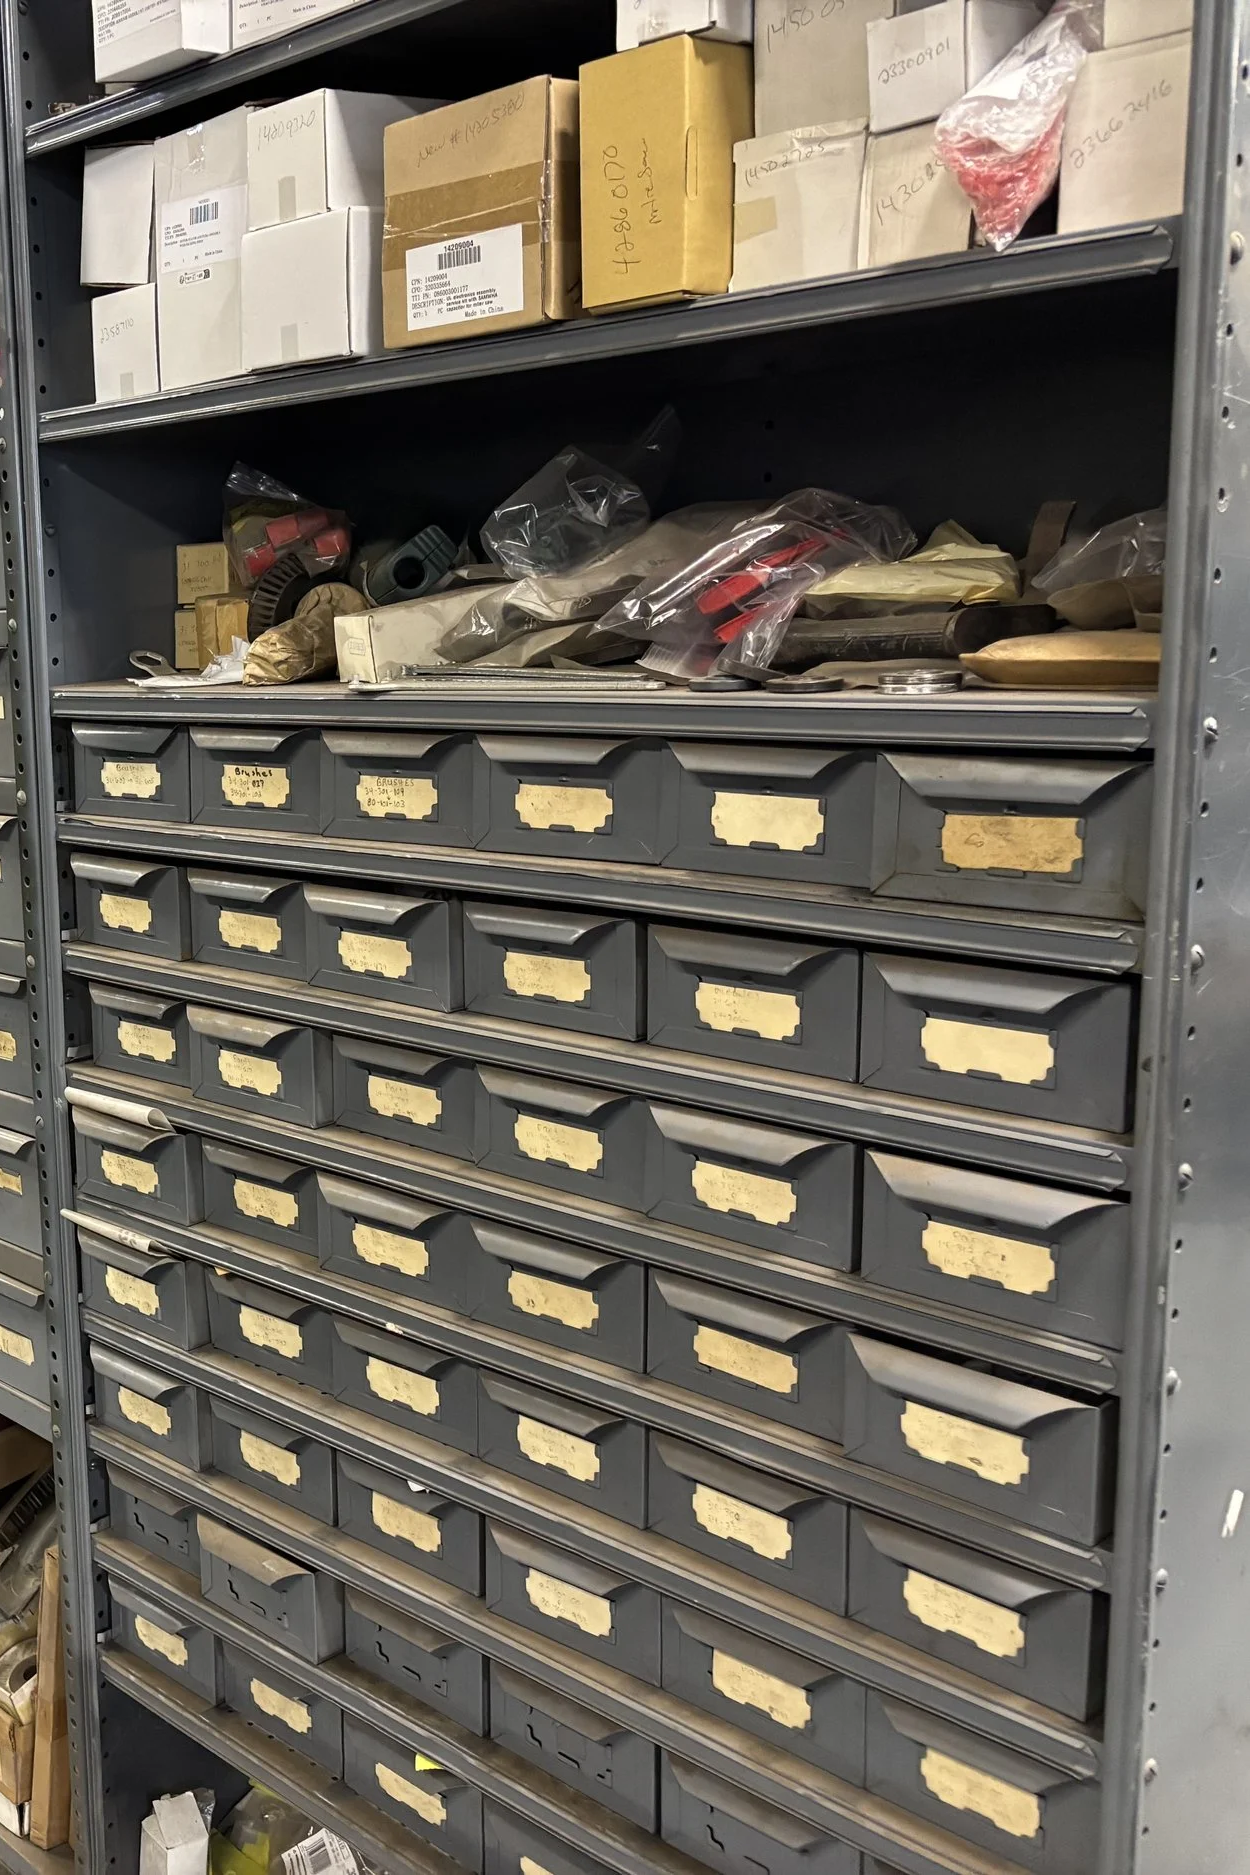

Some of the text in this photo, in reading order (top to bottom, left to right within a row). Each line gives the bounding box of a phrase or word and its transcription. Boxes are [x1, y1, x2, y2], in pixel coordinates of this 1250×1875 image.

[444, 240, 475, 252] 14209004
[425, 273, 448, 284] 14209004
[453, 292, 475, 300] electronics
[476, 288, 496, 297] assembly
[465, 309, 477, 318] Made
[488, 305, 504, 314] China
[234, 766, 273, 778] Brushes
[376, 777, 414, 787] BRUSHES
